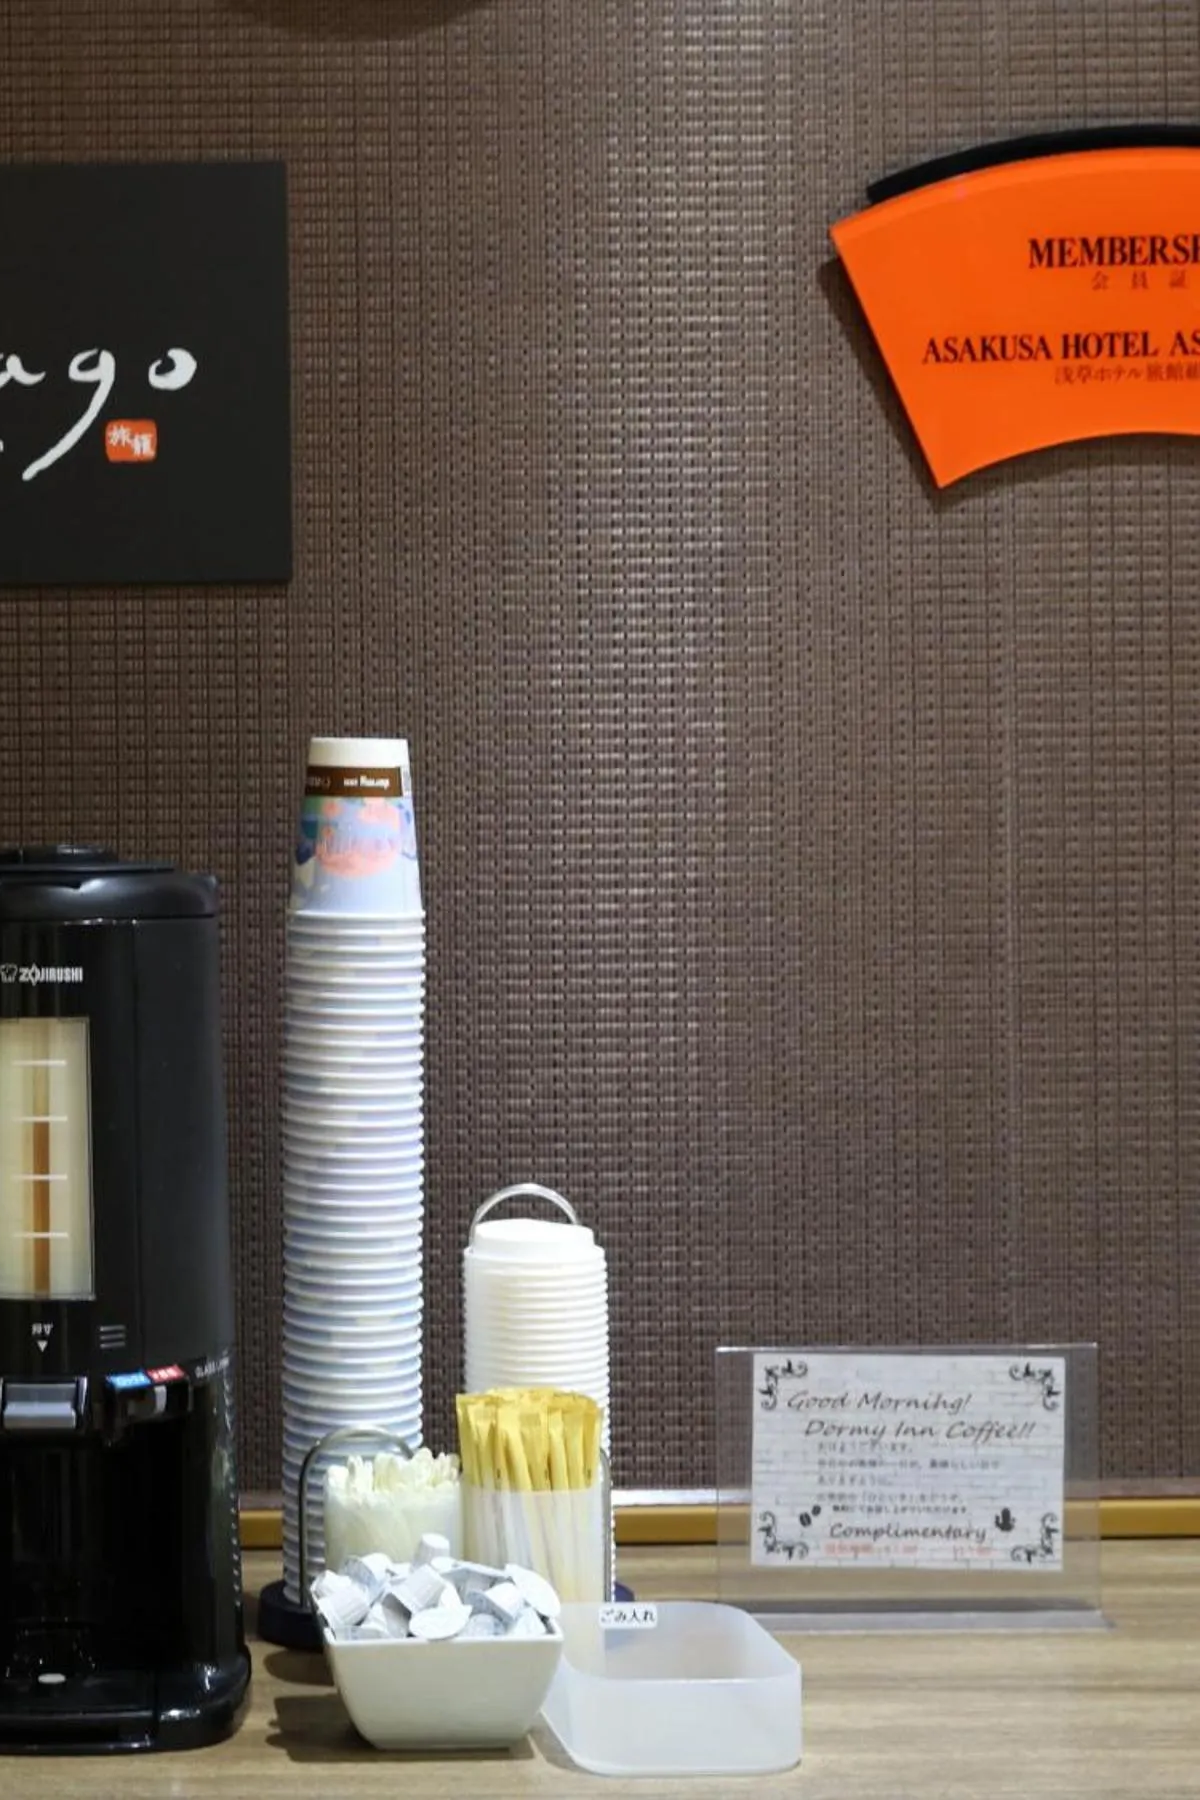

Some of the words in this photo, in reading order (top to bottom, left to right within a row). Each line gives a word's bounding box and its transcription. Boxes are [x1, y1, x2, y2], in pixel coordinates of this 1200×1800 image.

[922, 335, 1052, 365] ASAKUSA
[1062, 331, 1158, 360] HOTEL
[18, 963, 84, 986] ZOJIRUSHI
[787, 1390, 850, 1412] Good
[857, 1391, 973, 1415] Morning!
[804, 1420, 886, 1445] Dormy
[894, 1421, 936, 1439] Inn
[945, 1420, 1035, 1446] Coffee!!
[829, 1522, 987, 1544] Complimentary
[601, 1608, 655, 1623] ごみ入れ
